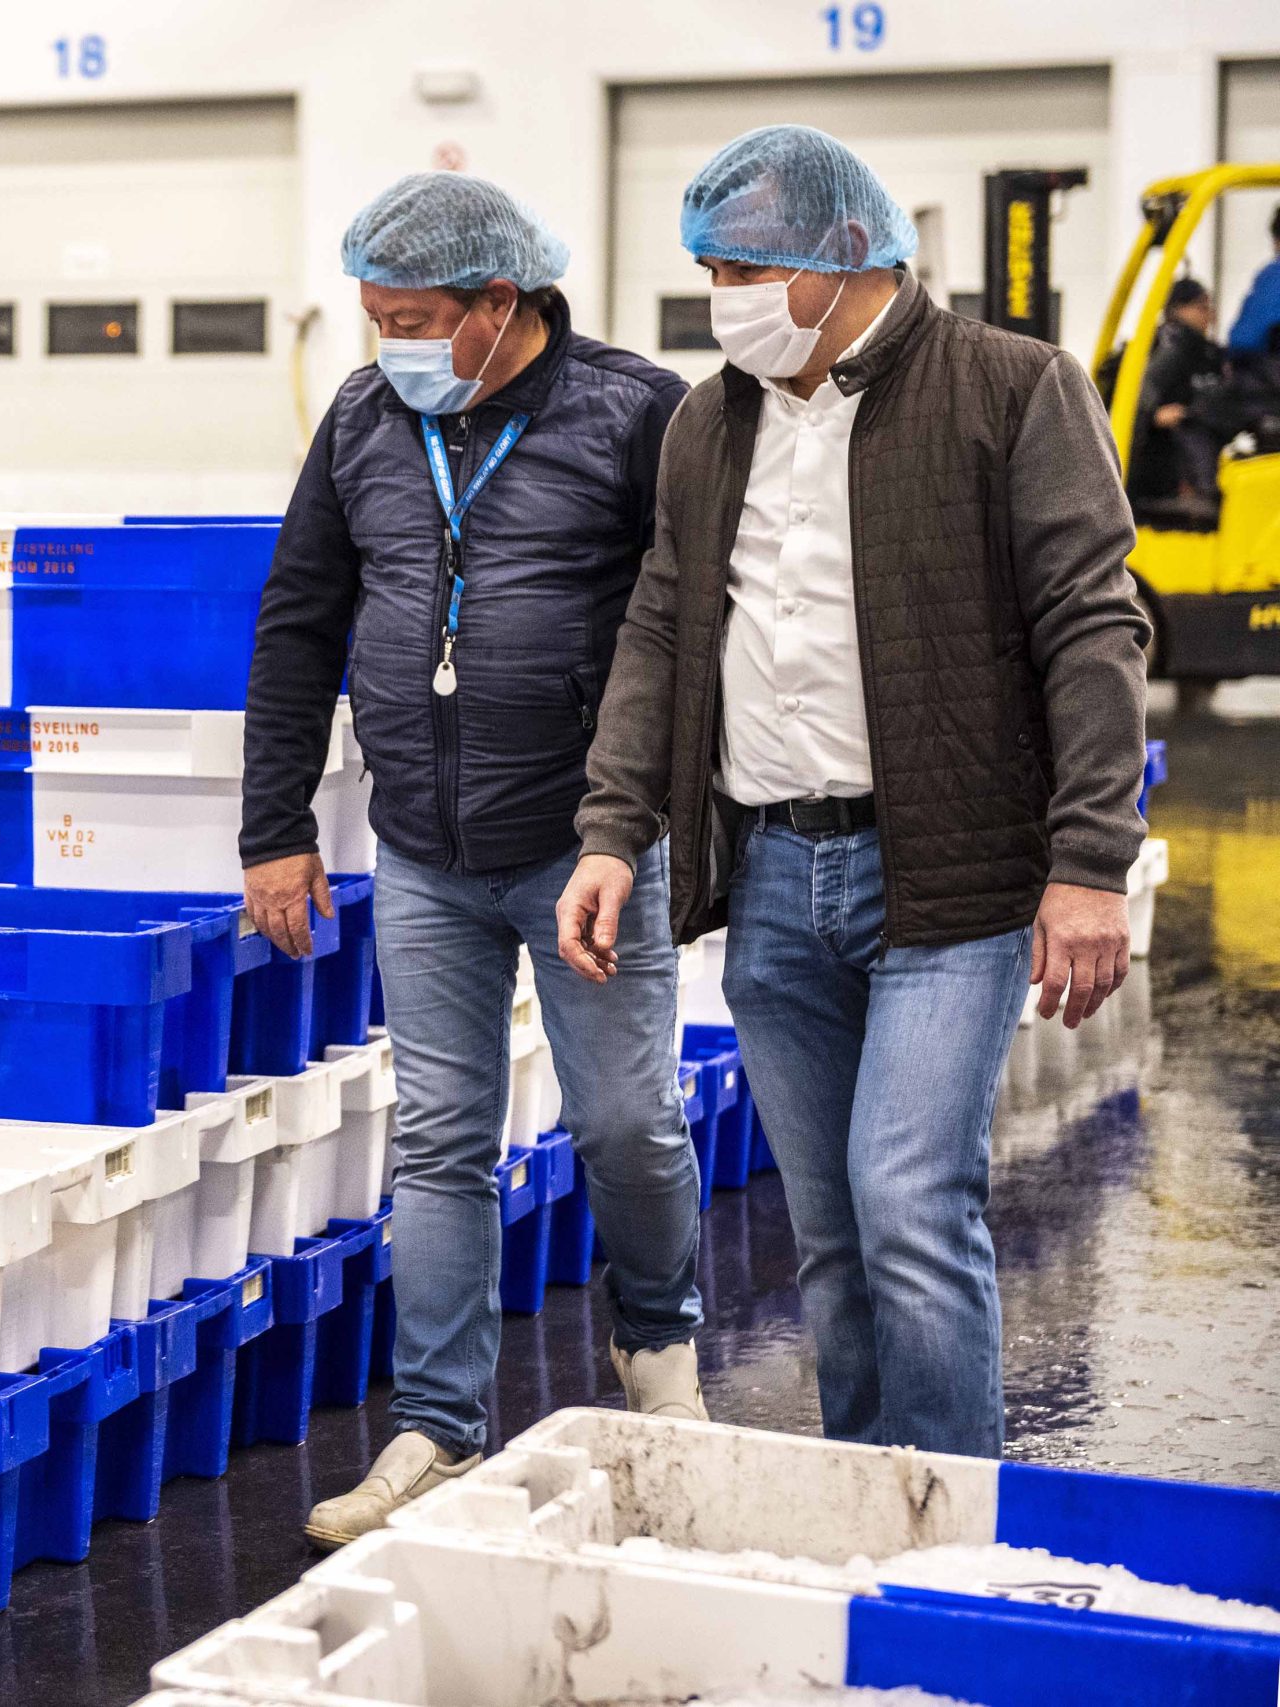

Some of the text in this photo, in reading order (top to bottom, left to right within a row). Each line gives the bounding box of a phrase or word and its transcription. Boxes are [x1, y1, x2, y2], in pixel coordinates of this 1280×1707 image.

[823, 4, 885, 51] 19
[54, 35, 106, 80] 18
[488, 455, 498, 469] NO
[495, 433, 512, 457] GLORY
[43, 561, 75, 574] 2016
[48, 741, 80, 753] 2016
[63, 814, 72, 827] B
[47, 830, 95, 843] VM 02
[61, 844, 83, 857] EG
